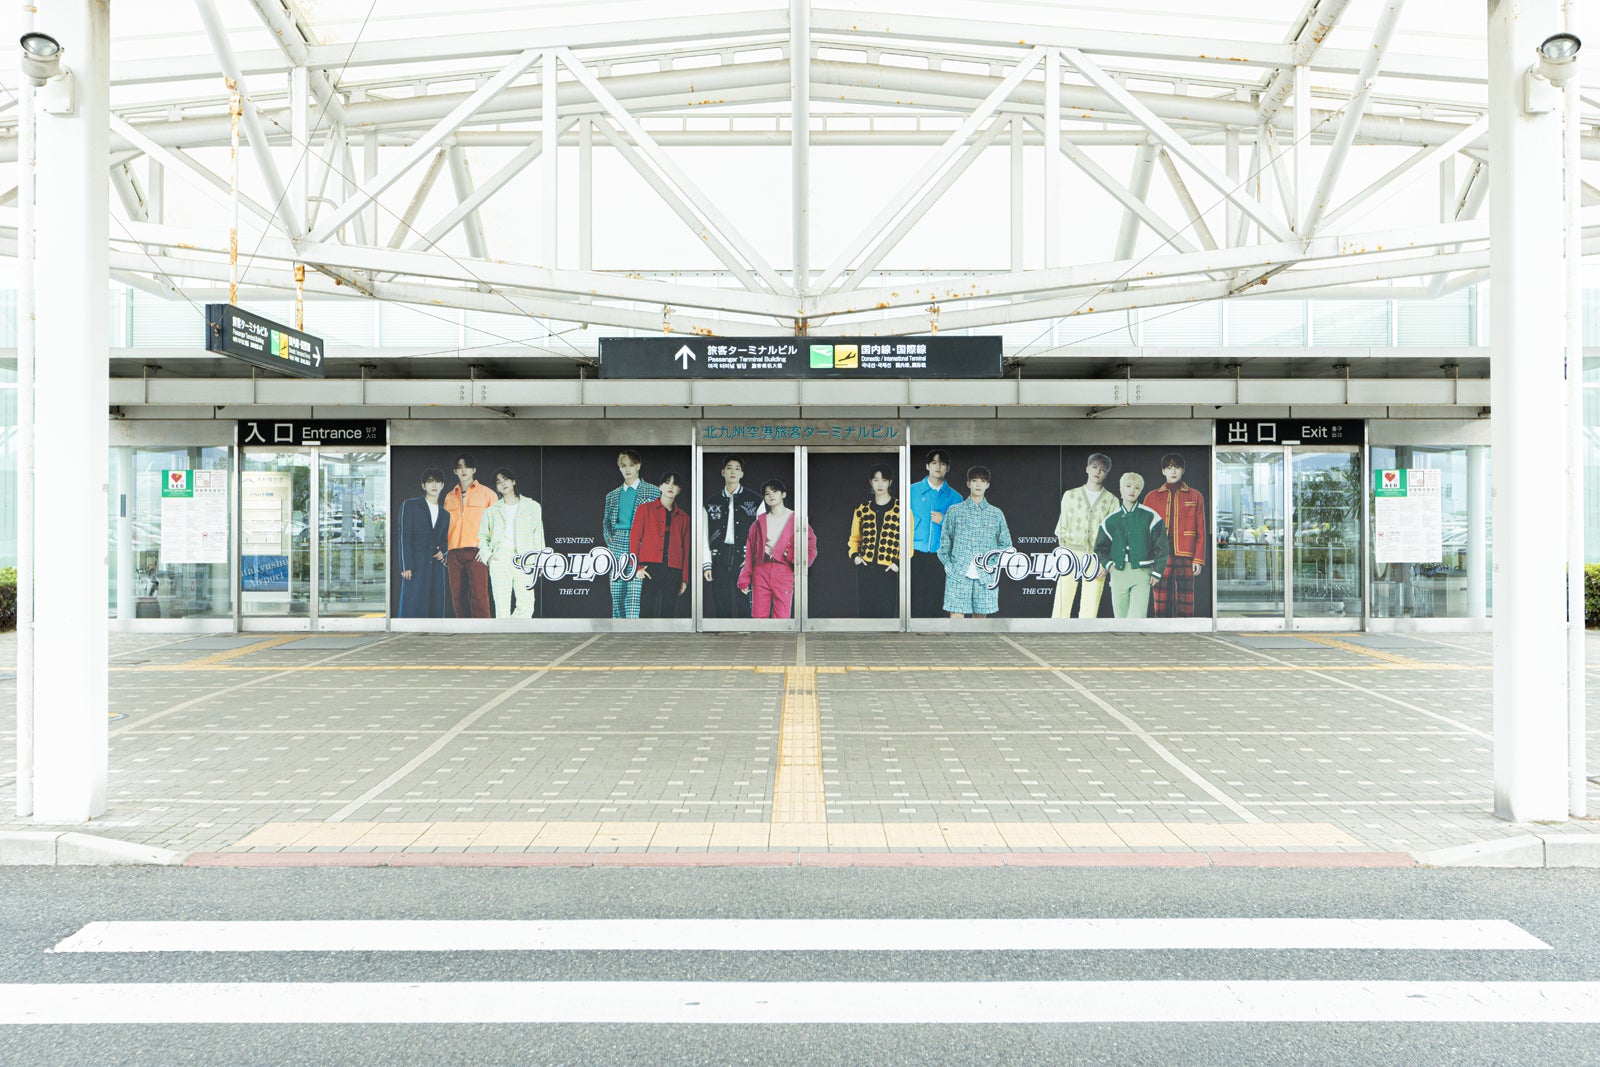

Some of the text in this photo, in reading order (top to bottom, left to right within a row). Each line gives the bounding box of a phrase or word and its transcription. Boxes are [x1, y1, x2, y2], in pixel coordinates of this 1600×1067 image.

[707, 345, 798, 356] 旅客ターミナルビル
[244, 422, 294, 443] 入口
[302, 427, 362, 439] Entrance
[703, 425, 899, 440] 北九州空港旅客ターミナルビル
[1228, 421, 1277, 443] 出口
[1301, 425, 1328, 438] Exit
[512, 546, 637, 590] FOLLOW
[974, 546, 1100, 590] FOLLOW
